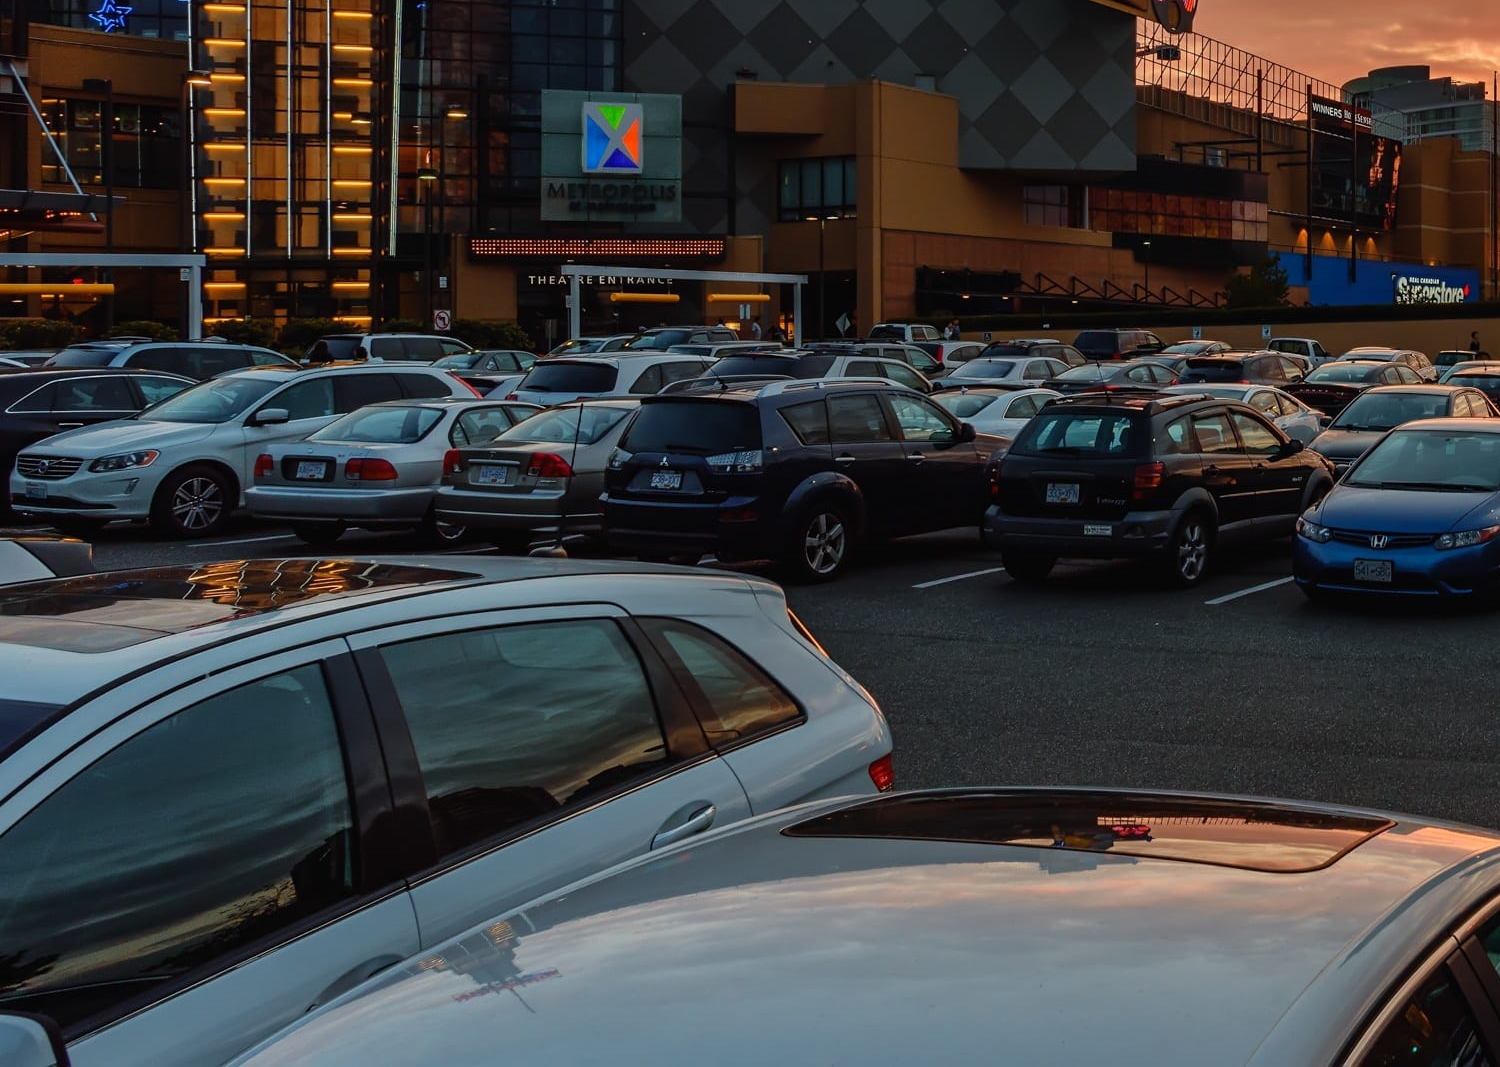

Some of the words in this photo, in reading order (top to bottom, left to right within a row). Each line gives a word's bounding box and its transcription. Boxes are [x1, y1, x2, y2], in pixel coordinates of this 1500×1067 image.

[1312, 102, 1343, 119] WINNERS
[547, 182, 677, 201] METROPOLIS
[1420, 277, 1440, 285] CANADIAN
